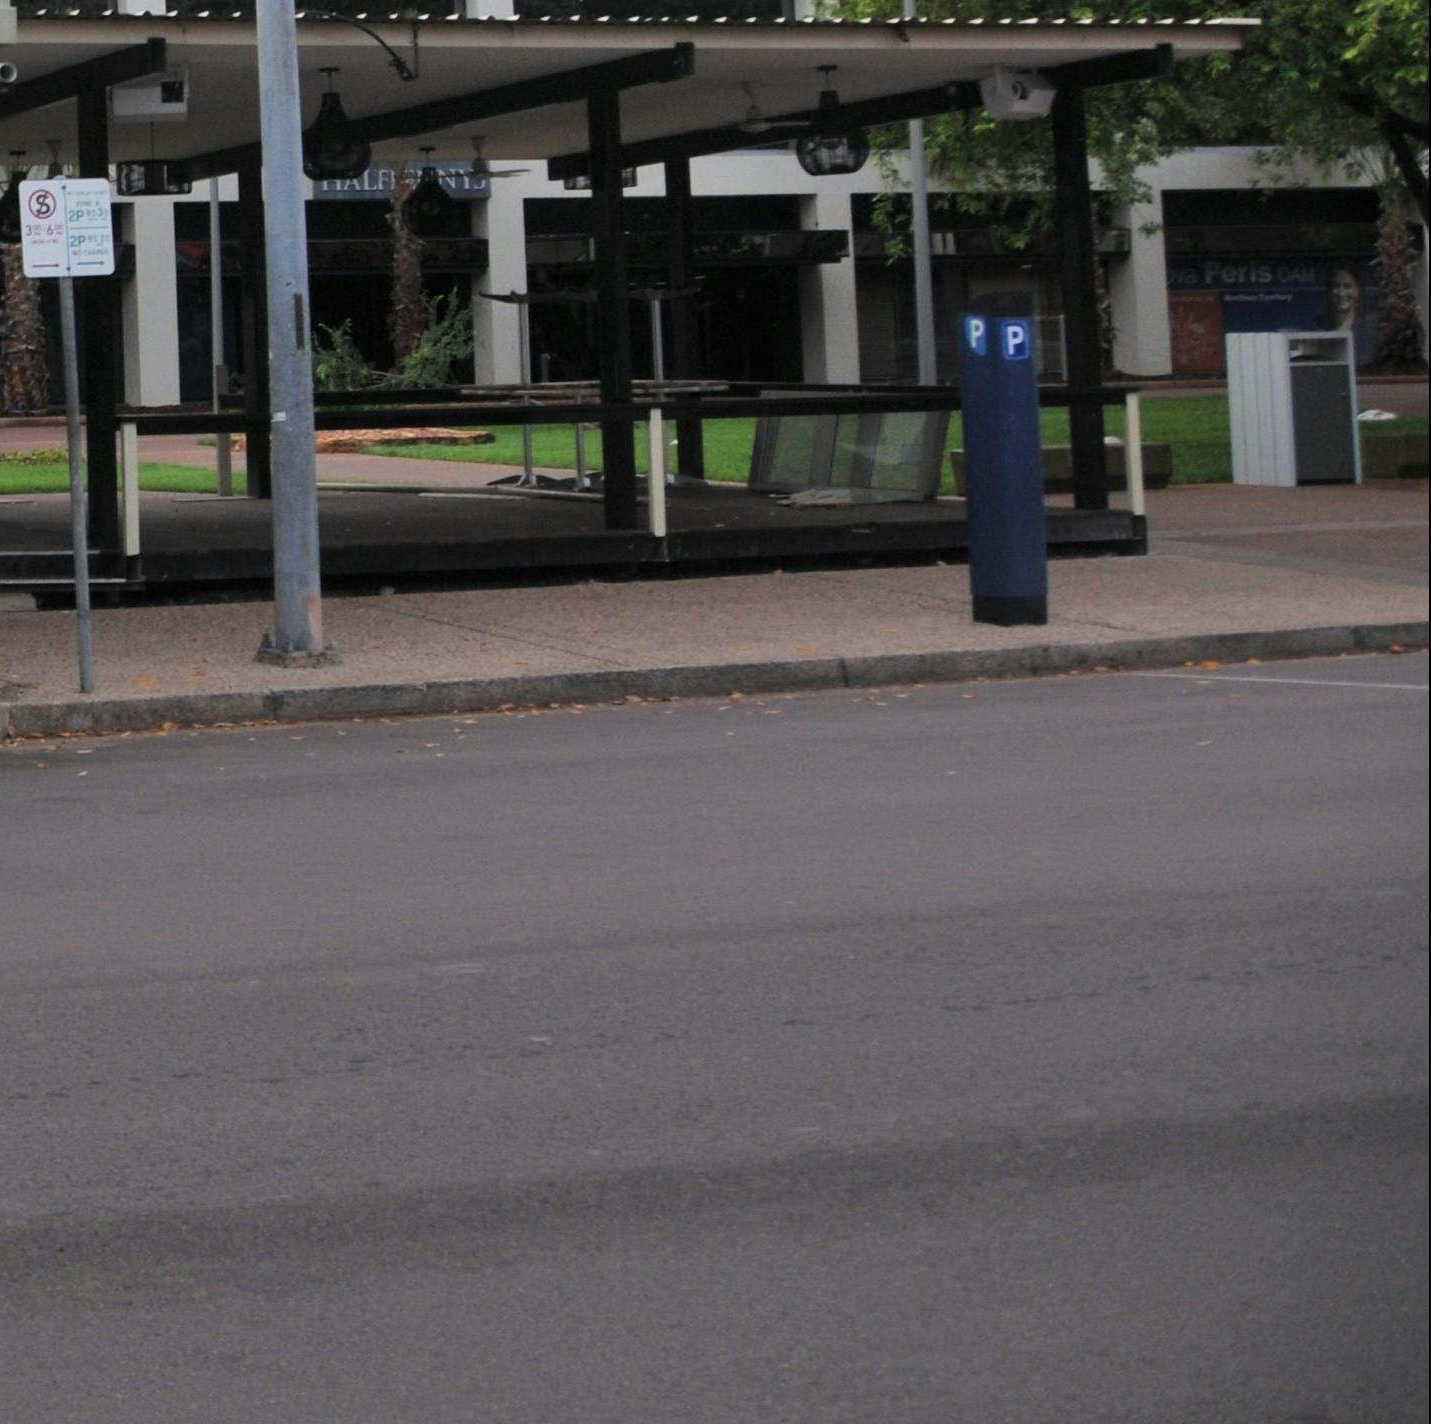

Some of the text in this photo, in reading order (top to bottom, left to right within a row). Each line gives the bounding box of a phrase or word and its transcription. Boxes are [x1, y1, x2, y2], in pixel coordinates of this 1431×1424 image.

[68, 209, 85, 222] 2P
[69, 235, 86, 247] 2P
[1204, 261, 1273, 284] Peris
[970, 319, 1024, 355] P P
